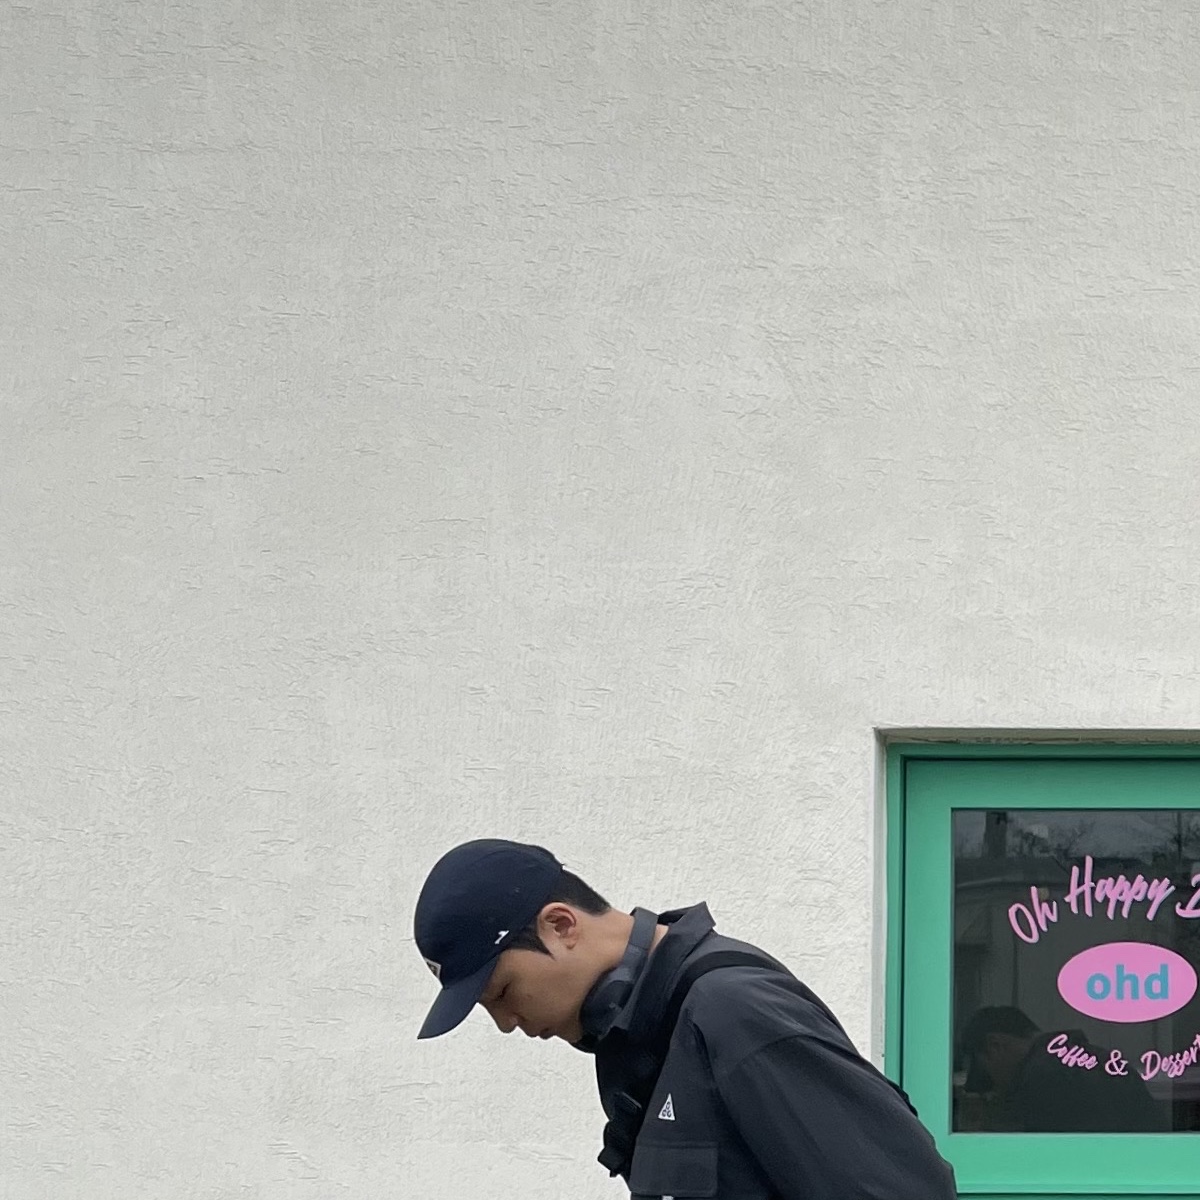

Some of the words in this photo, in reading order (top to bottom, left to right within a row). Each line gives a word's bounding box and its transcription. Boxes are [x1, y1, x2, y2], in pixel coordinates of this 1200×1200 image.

[1008, 886, 1058, 944] Oh
[1064, 855, 1176, 921] Happy
[1085, 963, 1170, 1002] ohd
[1046, 1034, 1099, 1071] Coffee
[1104, 1050, 1129, 1076] &
